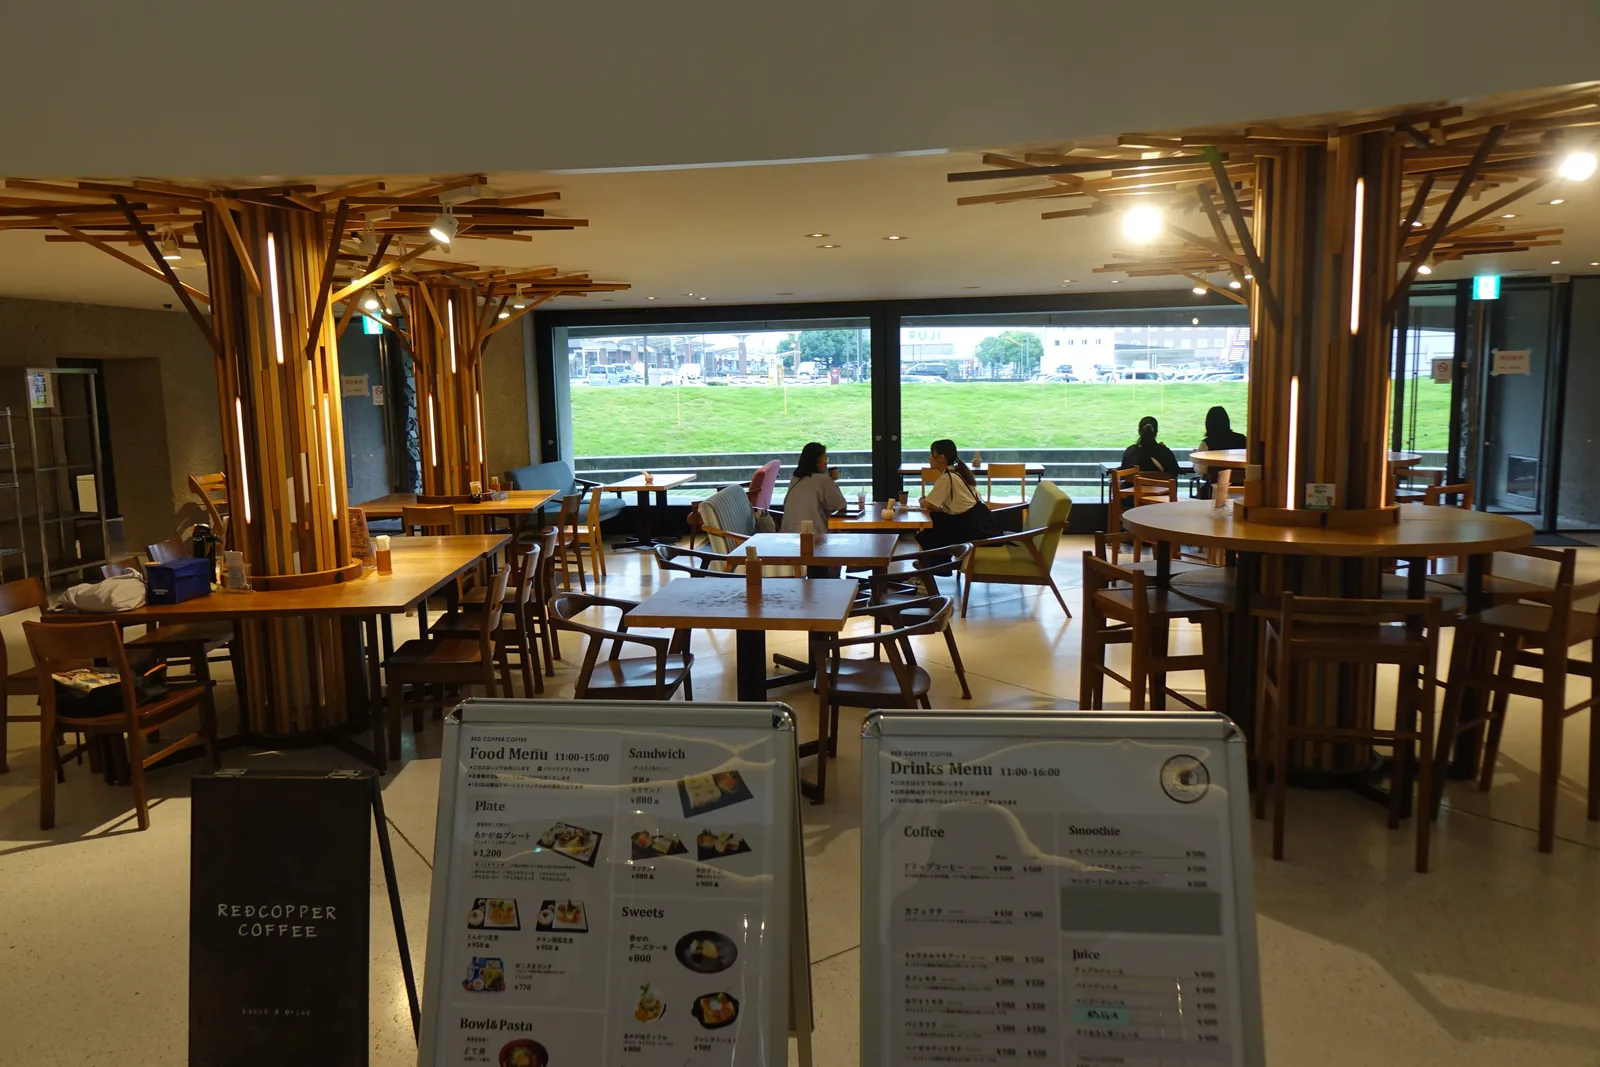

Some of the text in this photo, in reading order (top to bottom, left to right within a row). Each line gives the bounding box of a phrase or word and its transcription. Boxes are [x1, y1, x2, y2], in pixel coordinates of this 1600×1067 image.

[909, 330, 941, 341] FUJI
[470, 746, 609, 762] Food Menu 11:00-15:00
[629, 748, 685, 759] Sandwich
[891, 761, 1060, 777] Drinks Menu 11:00-16:00
[475, 800, 506, 811] Plate
[630, 796, 653, 804] ¥880
[904, 825, 945, 837] Coffee
[1069, 825, 1121, 836] Smoothie
[473, 849, 502, 859] ¥1,200
[217, 903, 337, 920] REDCOPPER
[621, 906, 664, 918] Sweets
[238, 923, 318, 938] COFFEE
[629, 943, 668, 952] チーズケーキ
[628, 954, 651, 963] ¥800
[1072, 949, 1101, 960] Juice
